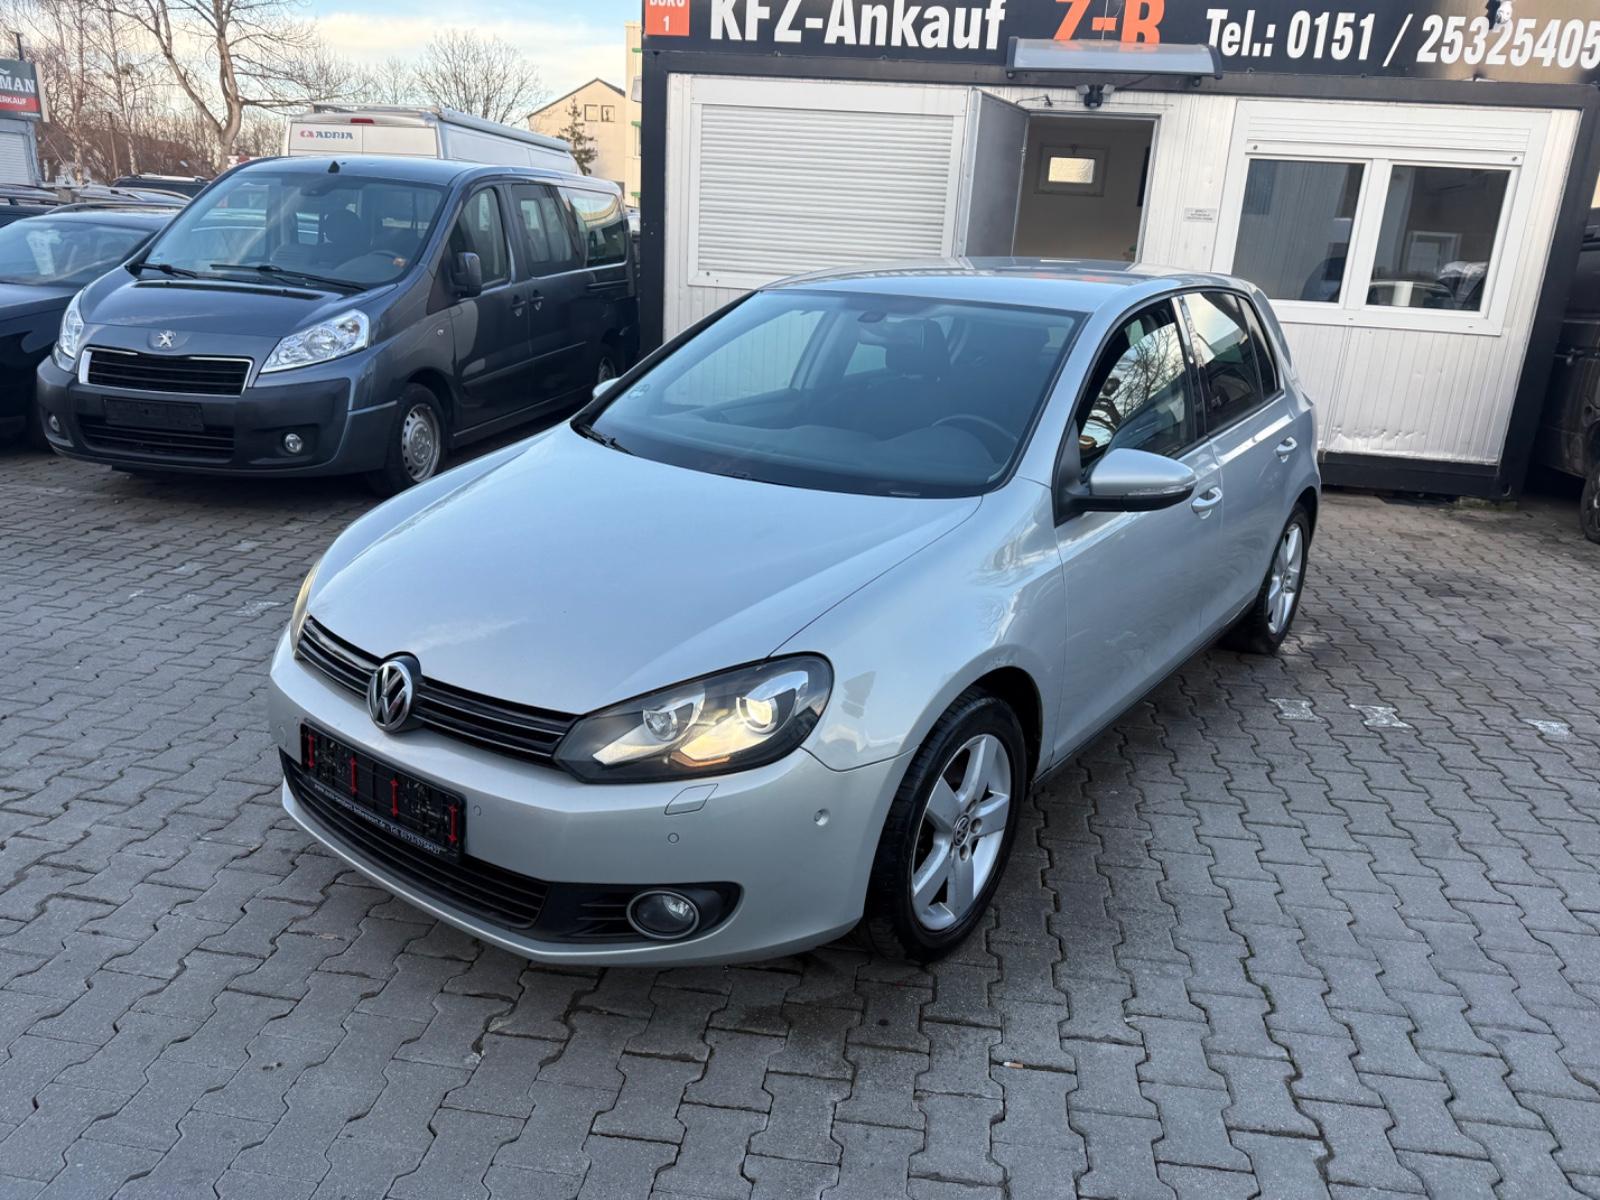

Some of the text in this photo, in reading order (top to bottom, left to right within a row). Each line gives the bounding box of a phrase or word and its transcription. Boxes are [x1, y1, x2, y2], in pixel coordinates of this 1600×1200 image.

[663, 15, 671, 32] 1
[710, 0, 1006, 50] KFZ-Ankauf
[1206, 8, 1276, 57] Tel.:
[1286, 10, 1375, 61] 0151
